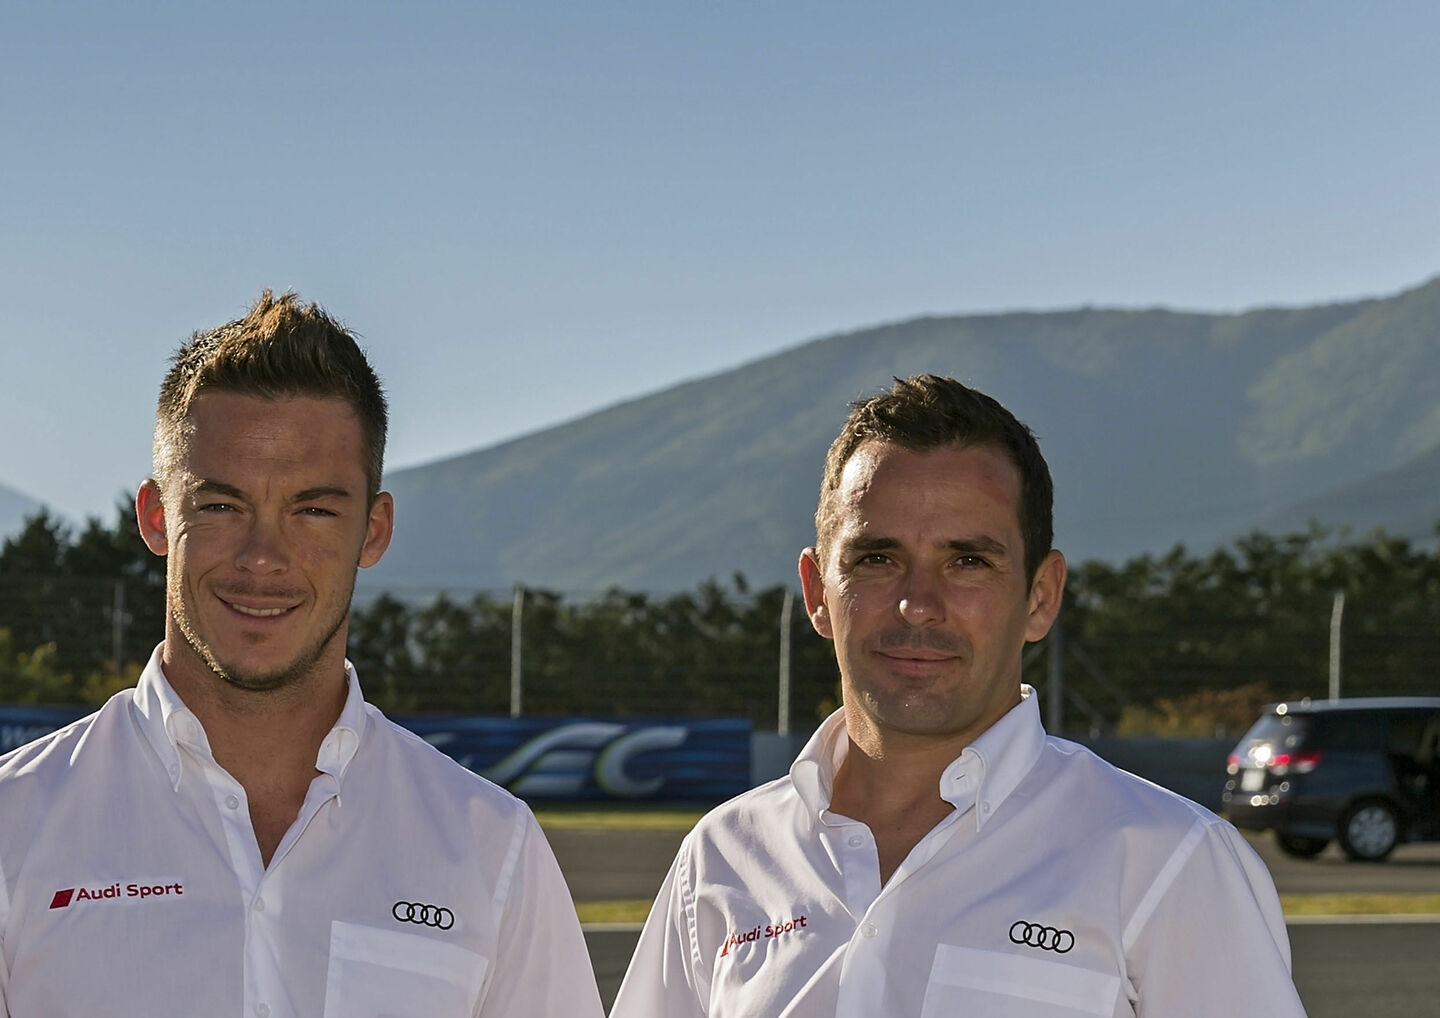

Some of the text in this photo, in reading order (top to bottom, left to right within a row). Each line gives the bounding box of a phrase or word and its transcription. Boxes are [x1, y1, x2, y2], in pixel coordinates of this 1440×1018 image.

[75, 882, 183, 902] Audi Sport
[729, 915, 808, 948] Audi Sport
